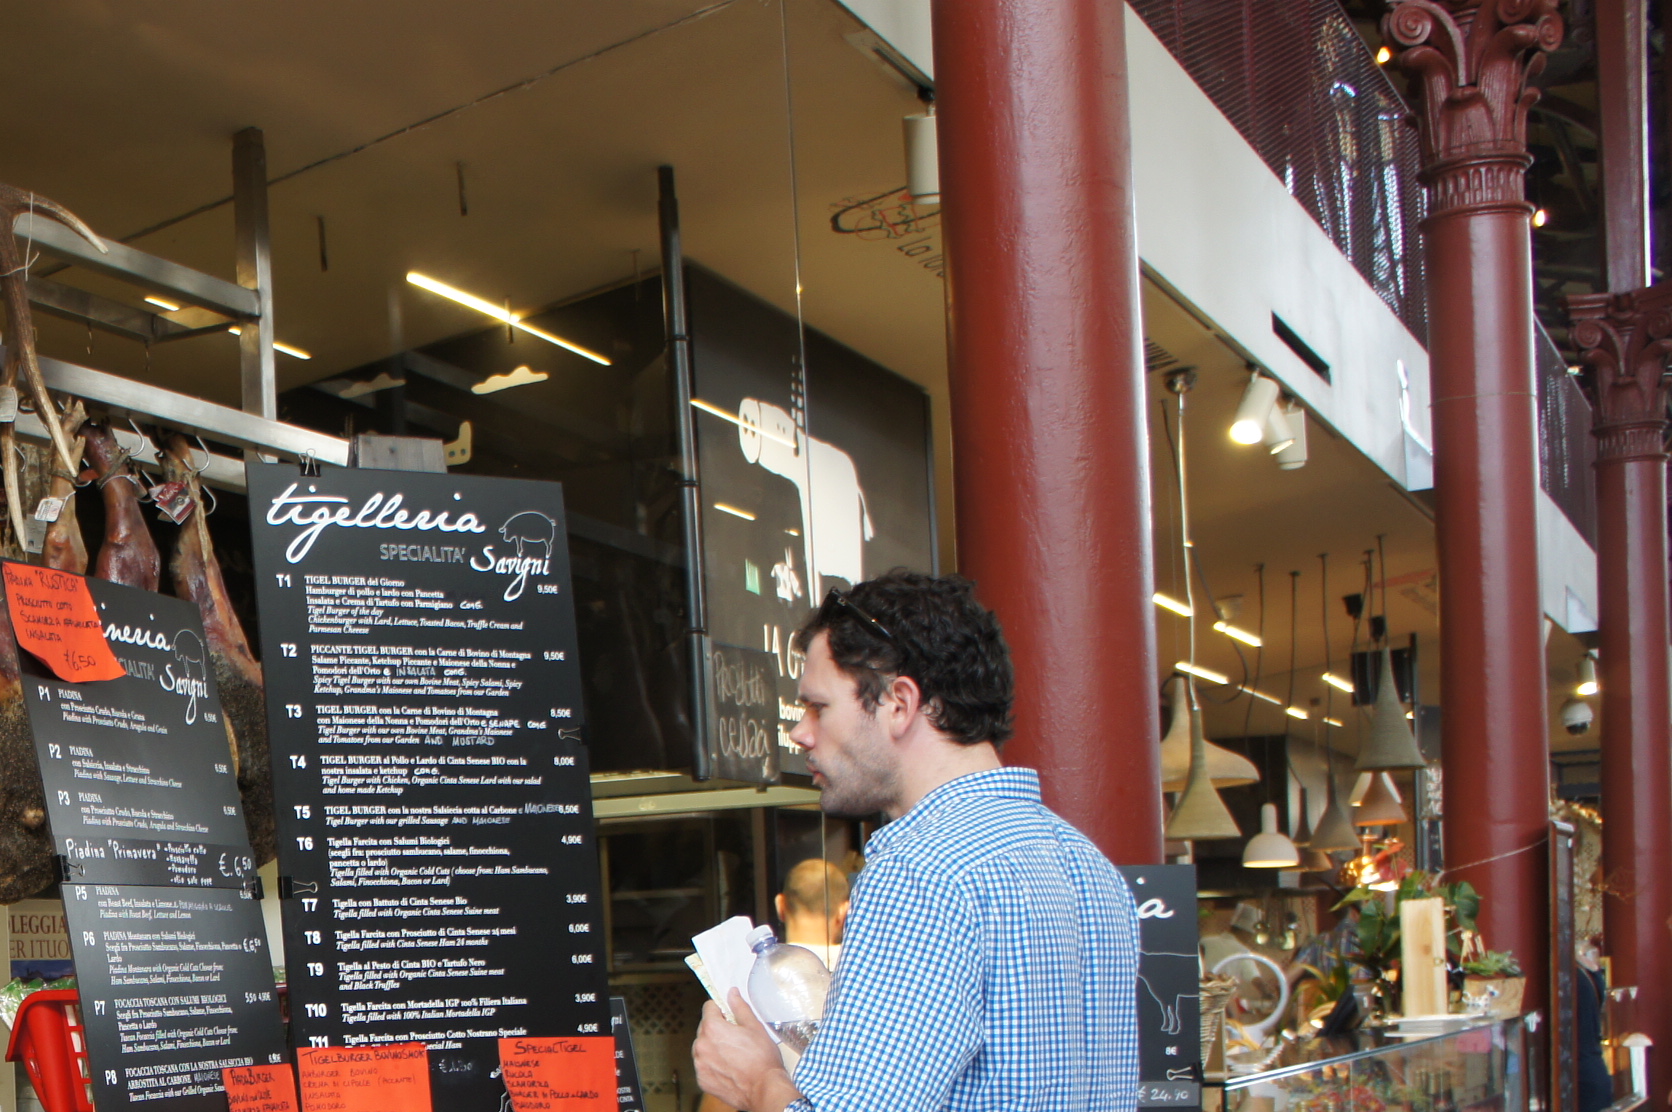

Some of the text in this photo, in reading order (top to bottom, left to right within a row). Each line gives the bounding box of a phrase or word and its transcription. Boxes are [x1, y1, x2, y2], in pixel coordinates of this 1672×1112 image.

[267, 483, 485, 563] tigelleria
[470, 545, 550, 601] Savigni
[276, 574, 558, 594] T1 TIGEL BURGER Giorno 9,50€
[306, 586, 374, 598] Hamburger pollo
[281, 644, 564, 661] T2 PICCANTE TIGEL BURGER 9,50€
[38, 685, 51, 701] P1
[159, 664, 208, 725] Savigni
[286, 705, 302, 718] T3
[453, 736, 495, 746] MUSTARD
[49, 743, 62, 759] P2
[290, 755, 306, 769] T4
[58, 790, 70, 806] P3
[294, 806, 311, 819] T5
[66, 838, 105, 860] Piadina
[297, 837, 313, 850] T6
[327, 837, 354, 847] Tigella
[75, 886, 87, 901] P5
[302, 898, 318, 912] T7
[83, 931, 95, 946] P6
[304, 931, 321, 944] T8
[307, 963, 324, 976] T9
[94, 1000, 106, 1015] P7
[305, 1004, 327, 1017] T10
[105, 1070, 117, 1085] P8
